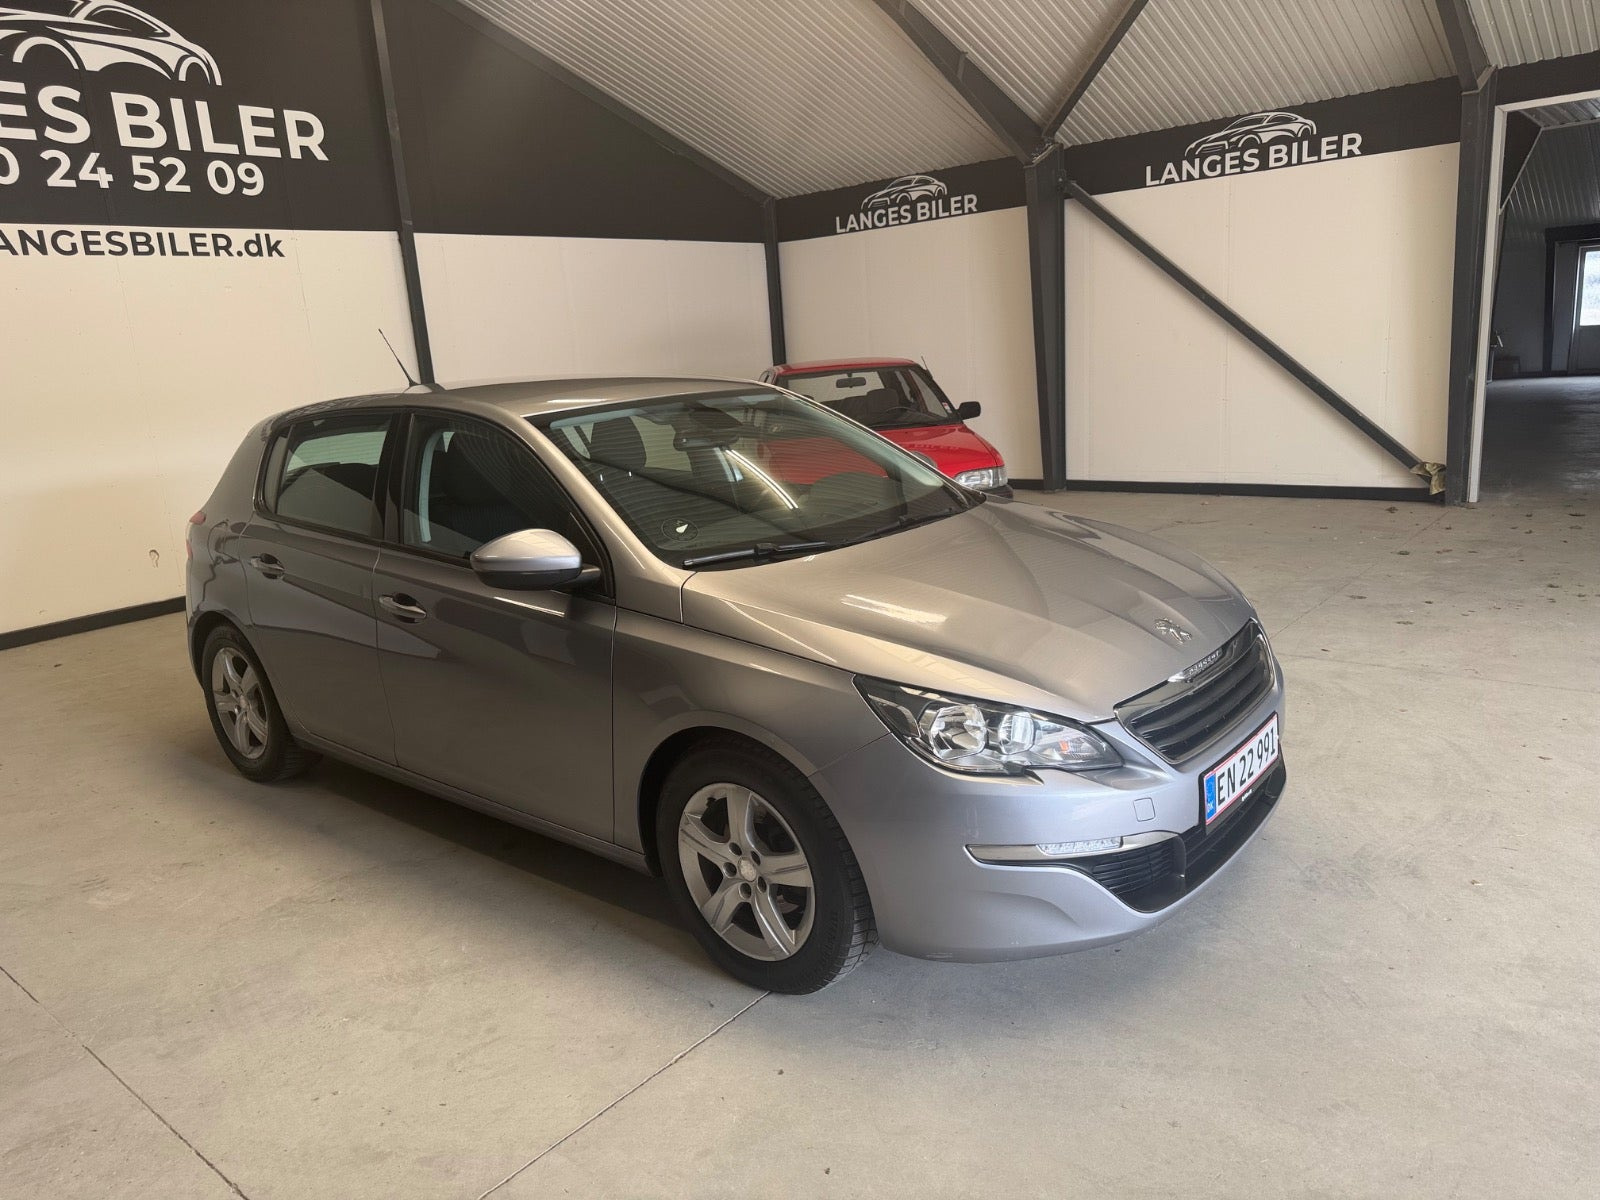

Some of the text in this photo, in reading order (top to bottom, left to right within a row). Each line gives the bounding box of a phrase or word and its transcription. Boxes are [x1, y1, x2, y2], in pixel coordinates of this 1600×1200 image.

[110, 91, 329, 162] BILER
[40, 149, 114, 189] 24
[131, 155, 191, 193] 52
[207, 160, 265, 196] 09
[1145, 132, 1363, 187] LANGES BILER
[835, 193, 978, 234] LANGES BILER
[1217, 727, 1276, 806] EN 22 991
